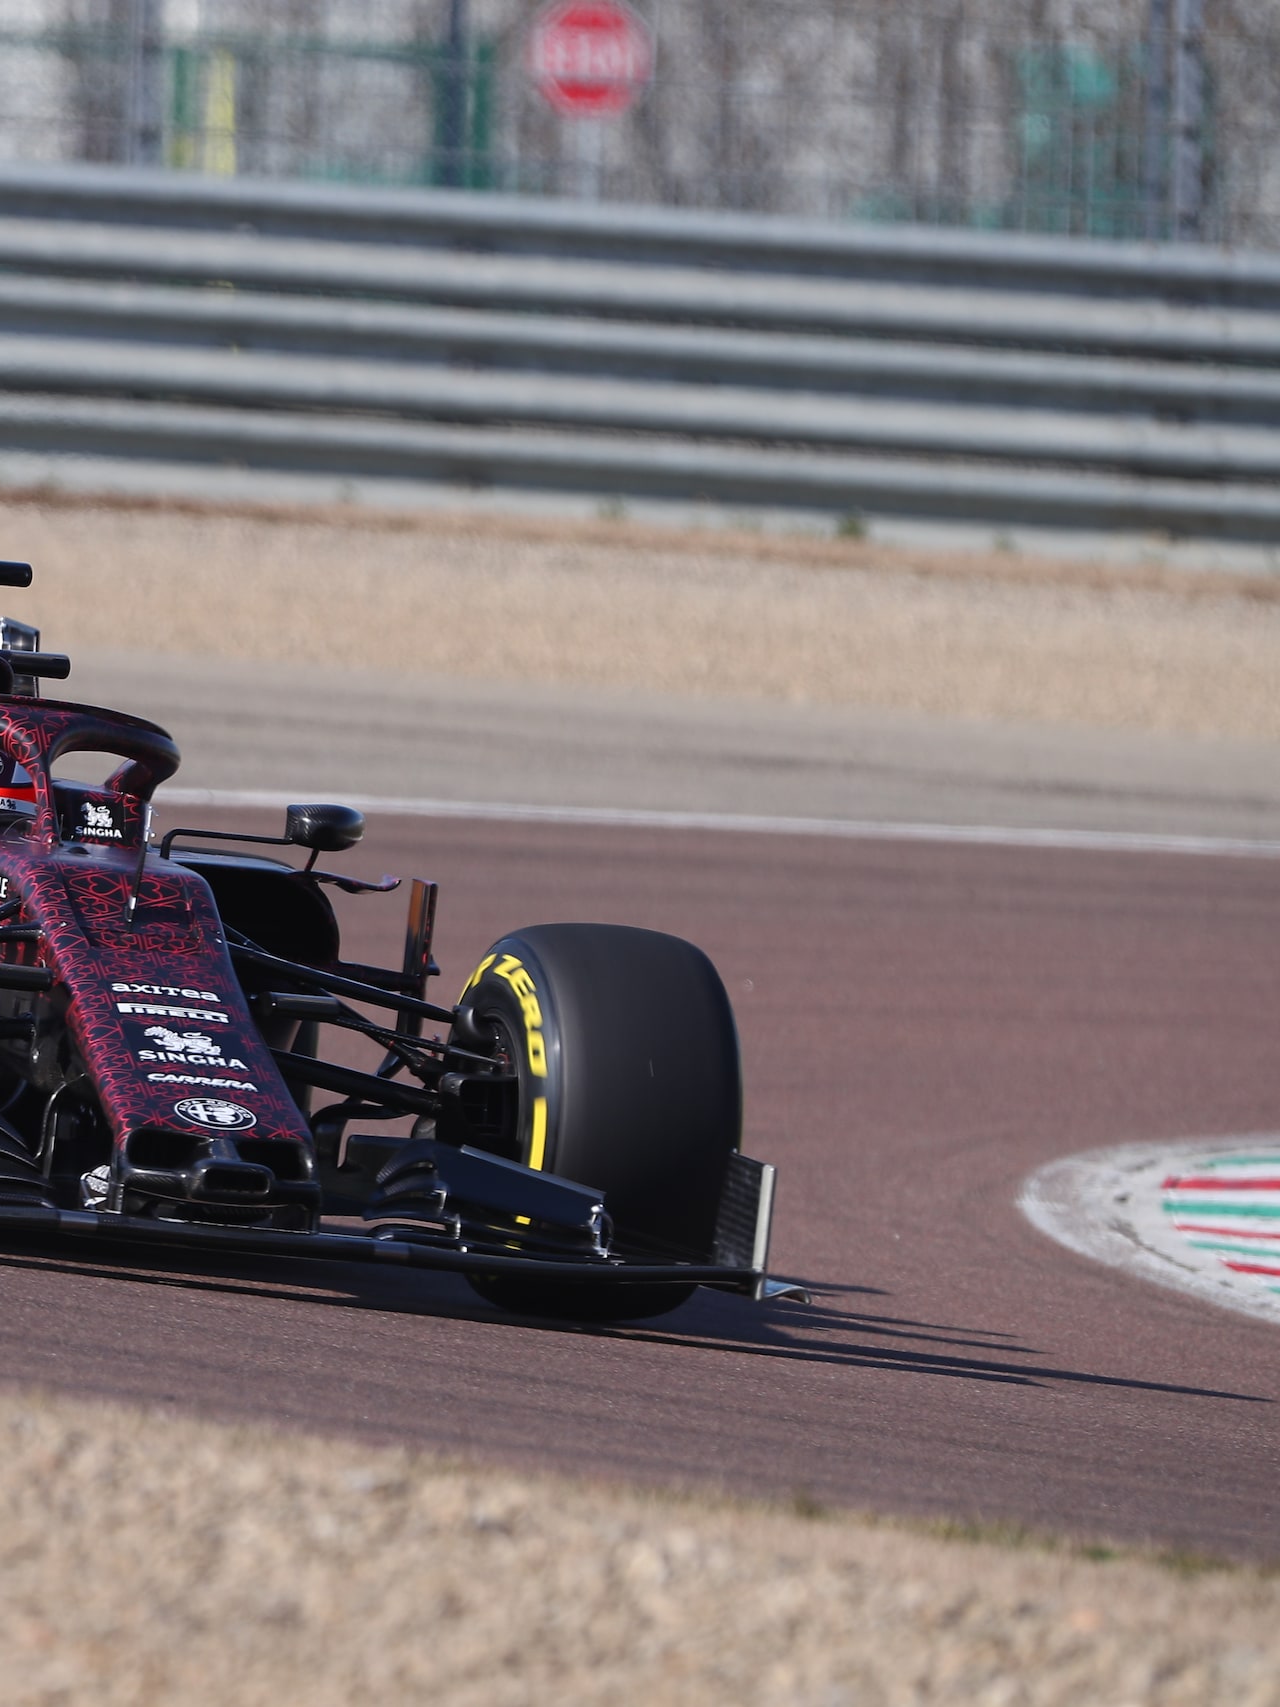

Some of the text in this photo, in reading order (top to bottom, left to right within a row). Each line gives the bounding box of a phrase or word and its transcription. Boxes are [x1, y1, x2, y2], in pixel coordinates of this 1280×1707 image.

[75, 825, 123, 839] SINGHA
[116, 1002, 229, 1024] PIRELLI
[493, 953, 549, 1079] ZERO
[138, 1049, 250, 1072] SINGHA
[147, 1072, 259, 1093] CARRERA
